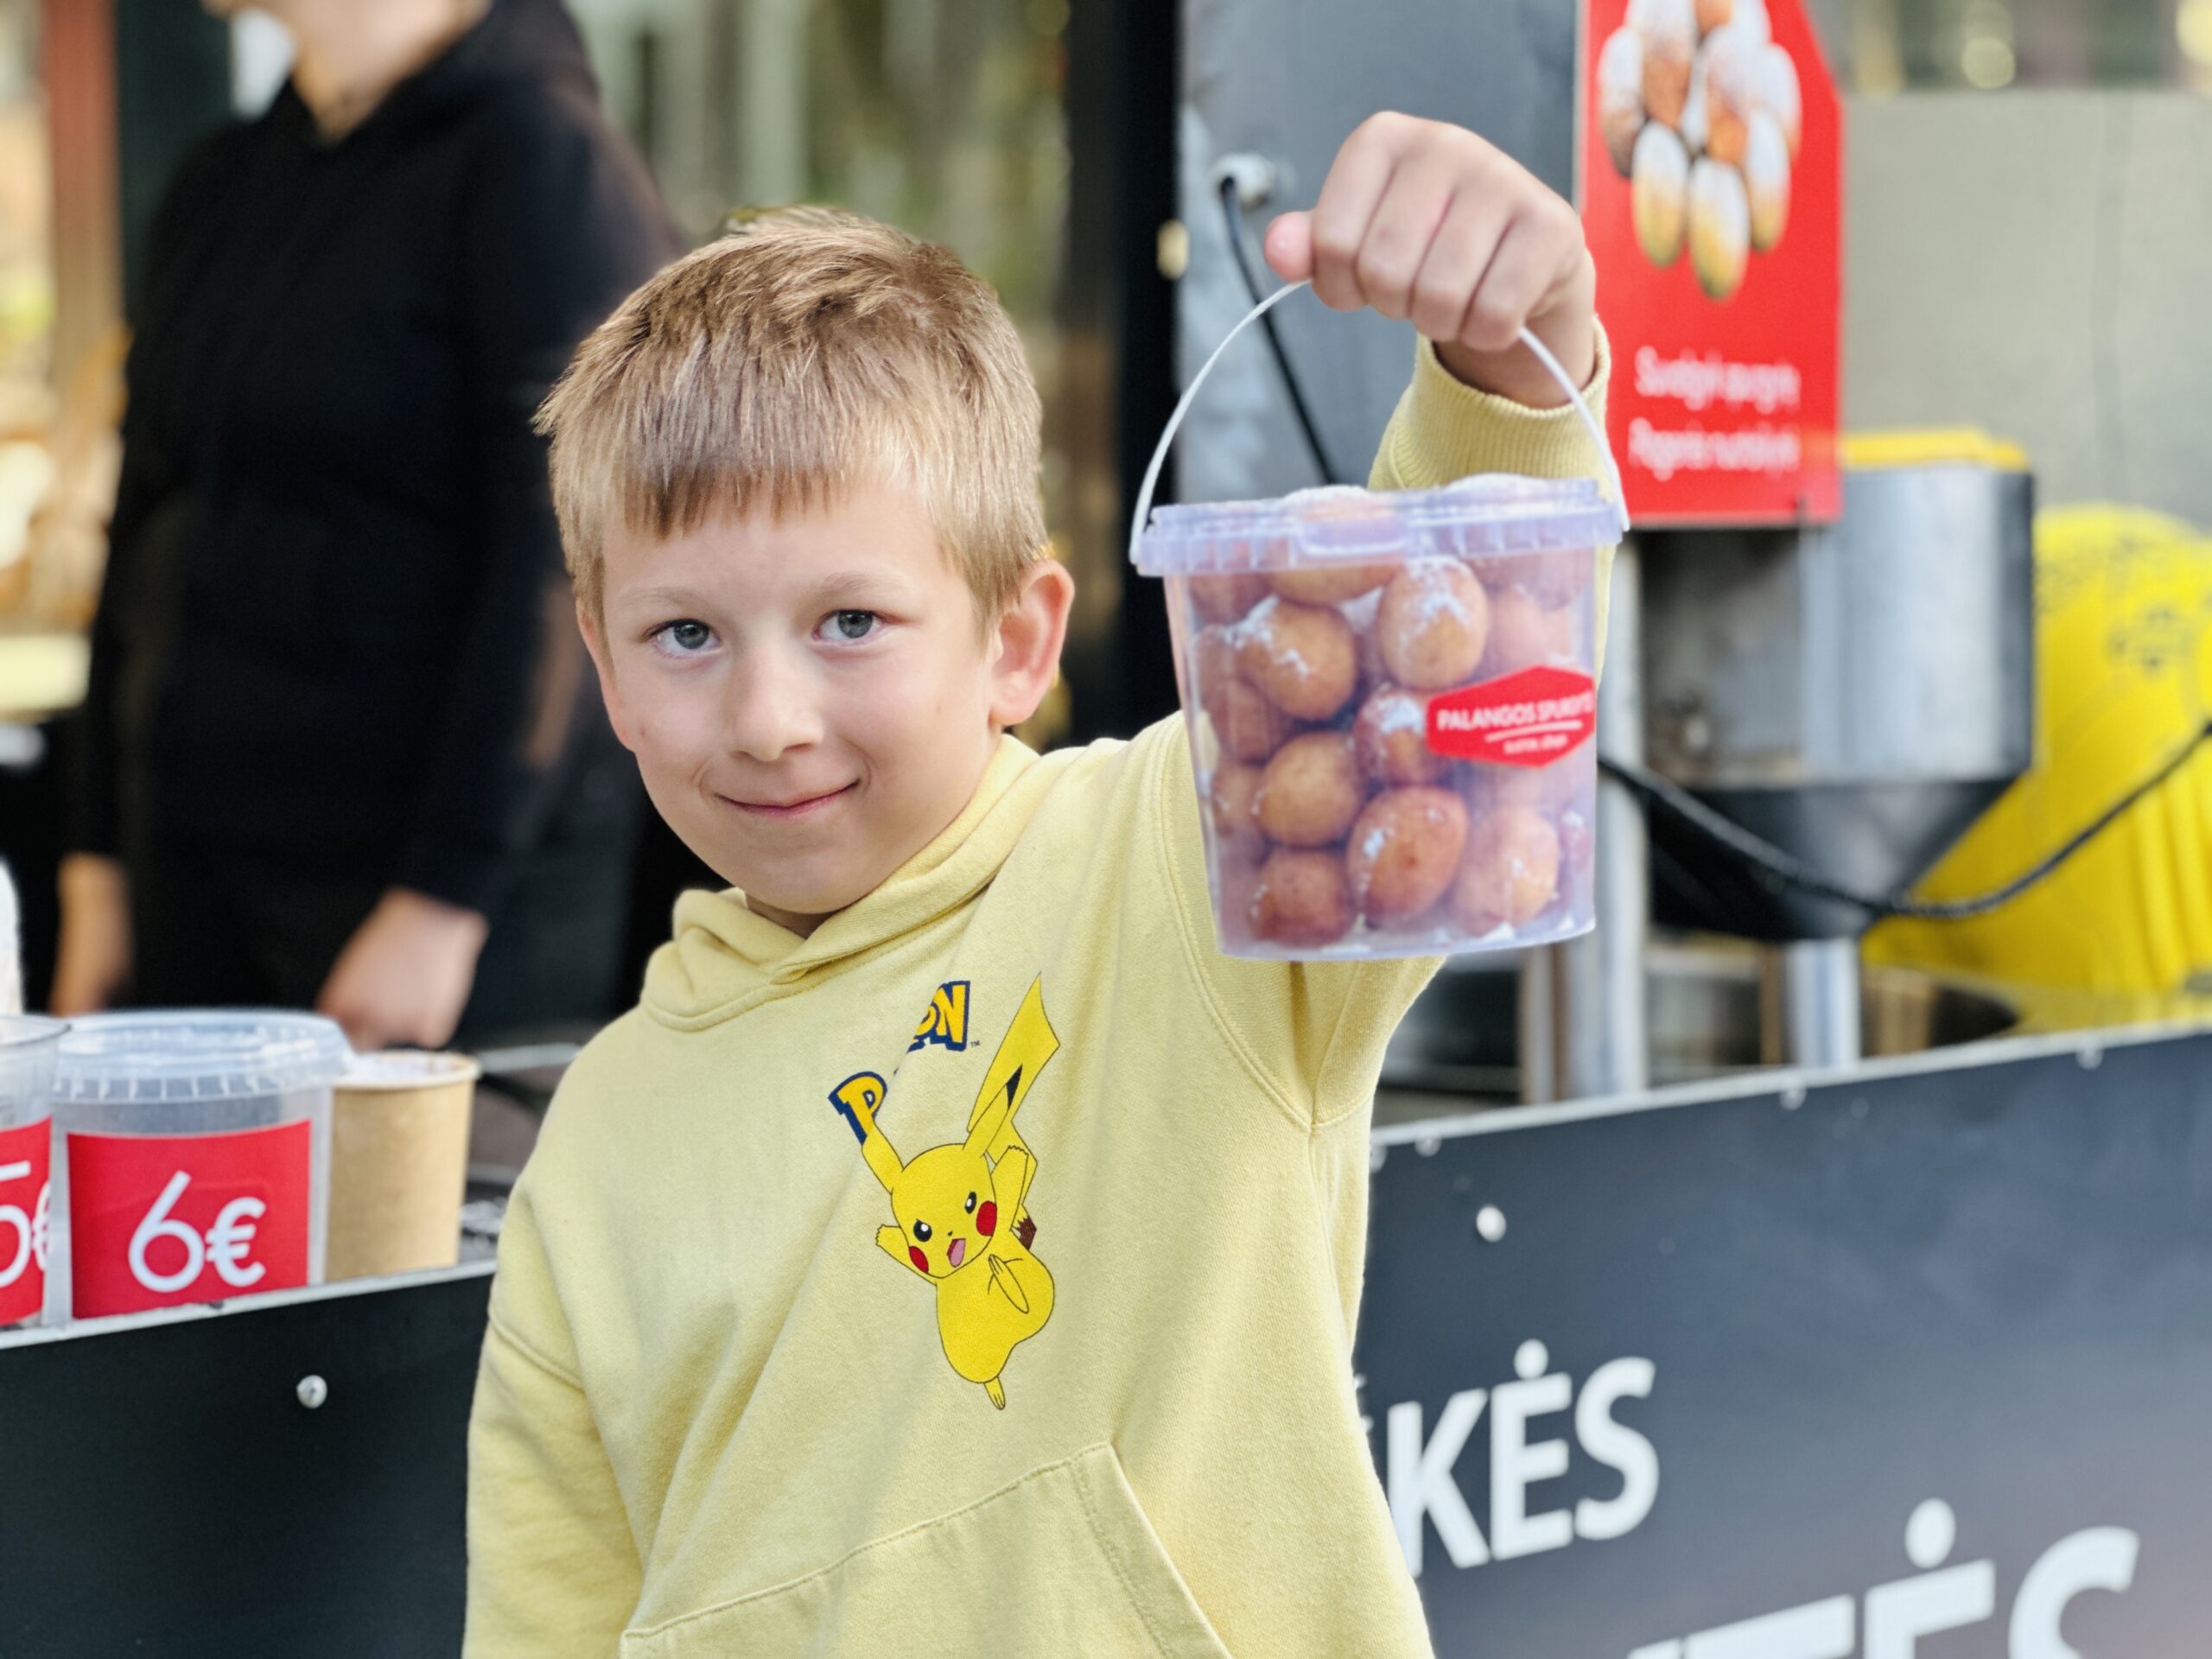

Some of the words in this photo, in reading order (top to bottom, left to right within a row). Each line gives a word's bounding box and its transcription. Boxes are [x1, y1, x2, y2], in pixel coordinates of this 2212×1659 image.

[1436, 702, 1535, 731] PALANGOS
[129, 1170, 266, 1292] 6€
[1354, 1339, 1659, 1579] KĖS
